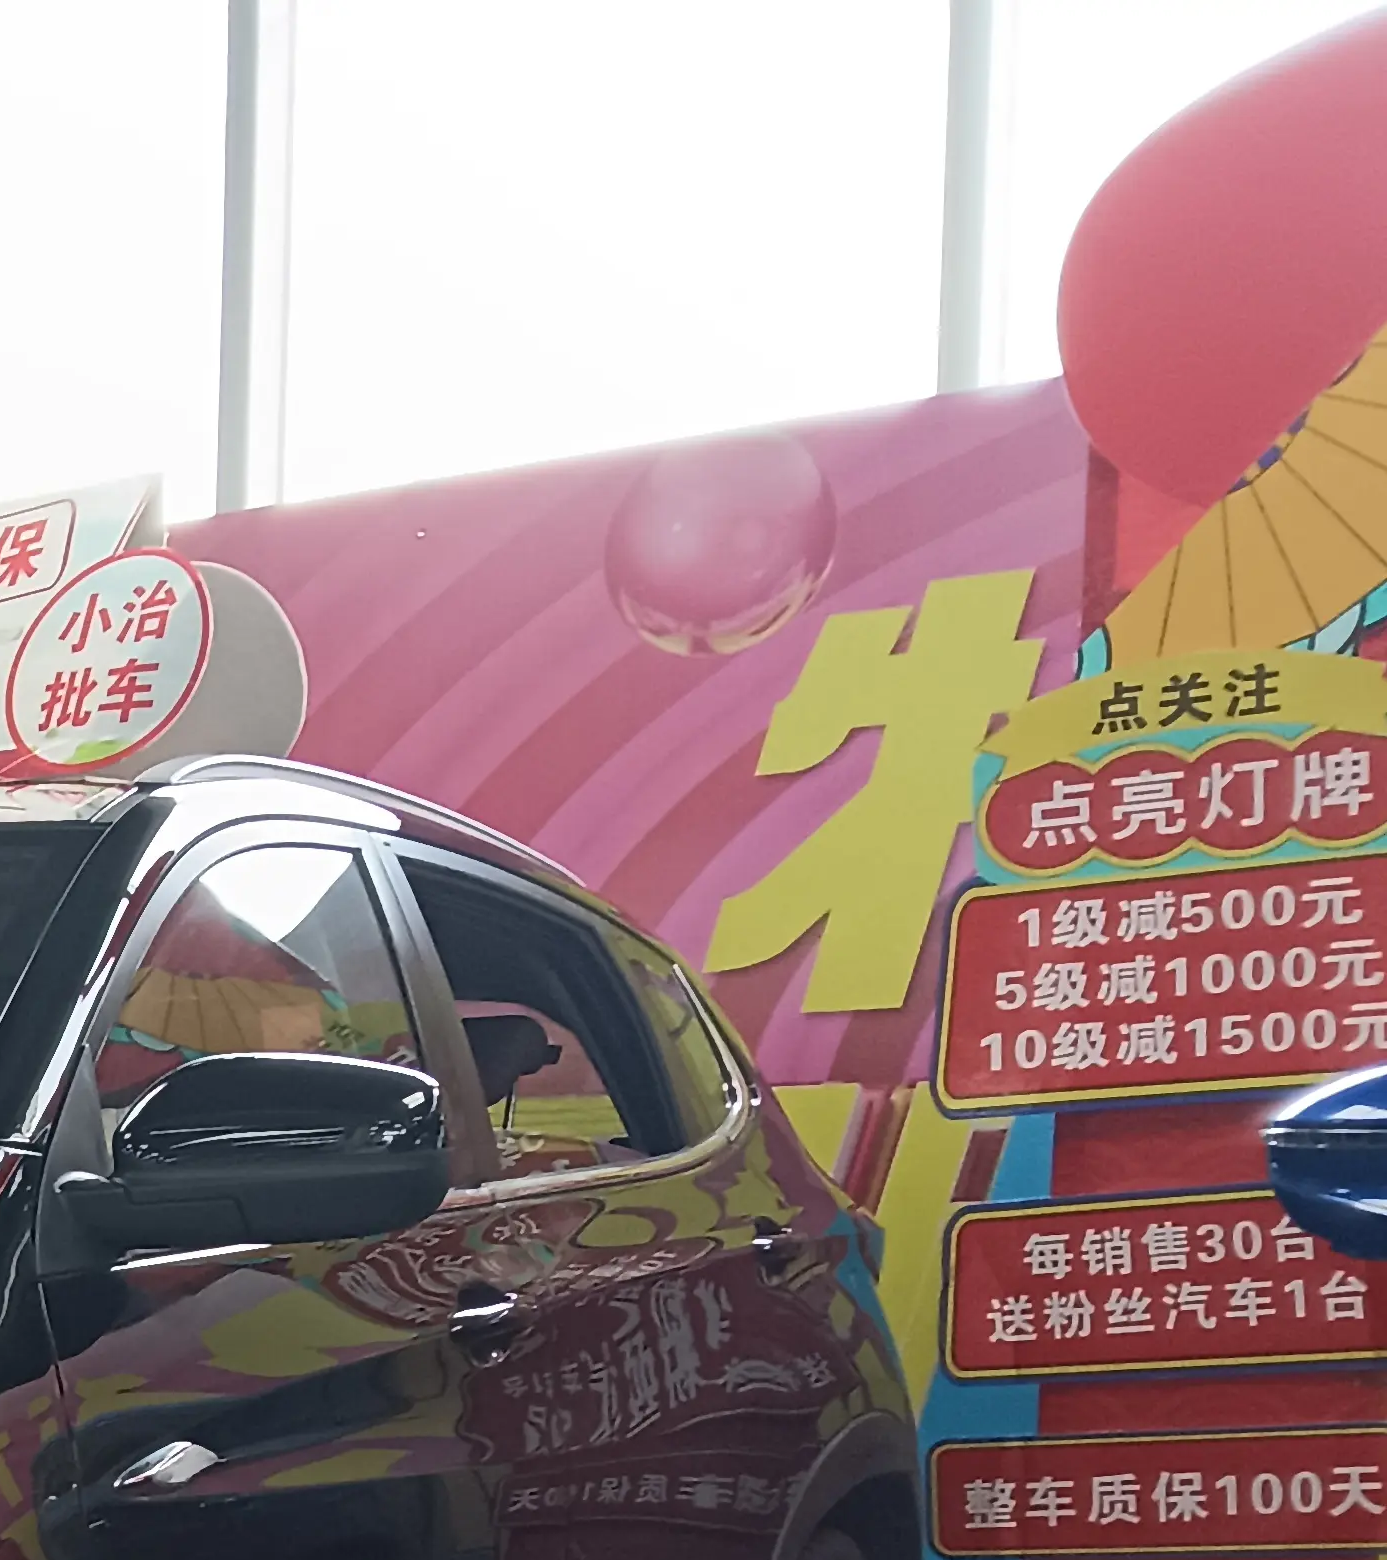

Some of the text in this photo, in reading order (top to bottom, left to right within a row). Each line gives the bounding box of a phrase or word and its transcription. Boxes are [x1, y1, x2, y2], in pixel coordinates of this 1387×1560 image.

[58, 578, 178, 655] 小治
[38, 657, 161, 732] 批车
[1092, 663, 1282, 735] 点关注
[1023, 746, 1374, 850] 点亮灯牌
[1017, 875, 1364, 949] 1级减500元
[994, 937, 1385, 1012] 5级减1000元
[980, 1001, 1387, 1073] 10级减1500元
[1022, 1217, 1316, 1281] 每销售30台
[986, 1270, 1368, 1345] 送粉丝汽车1台
[963, 1463, 1384, 1531] 整车质保100天
